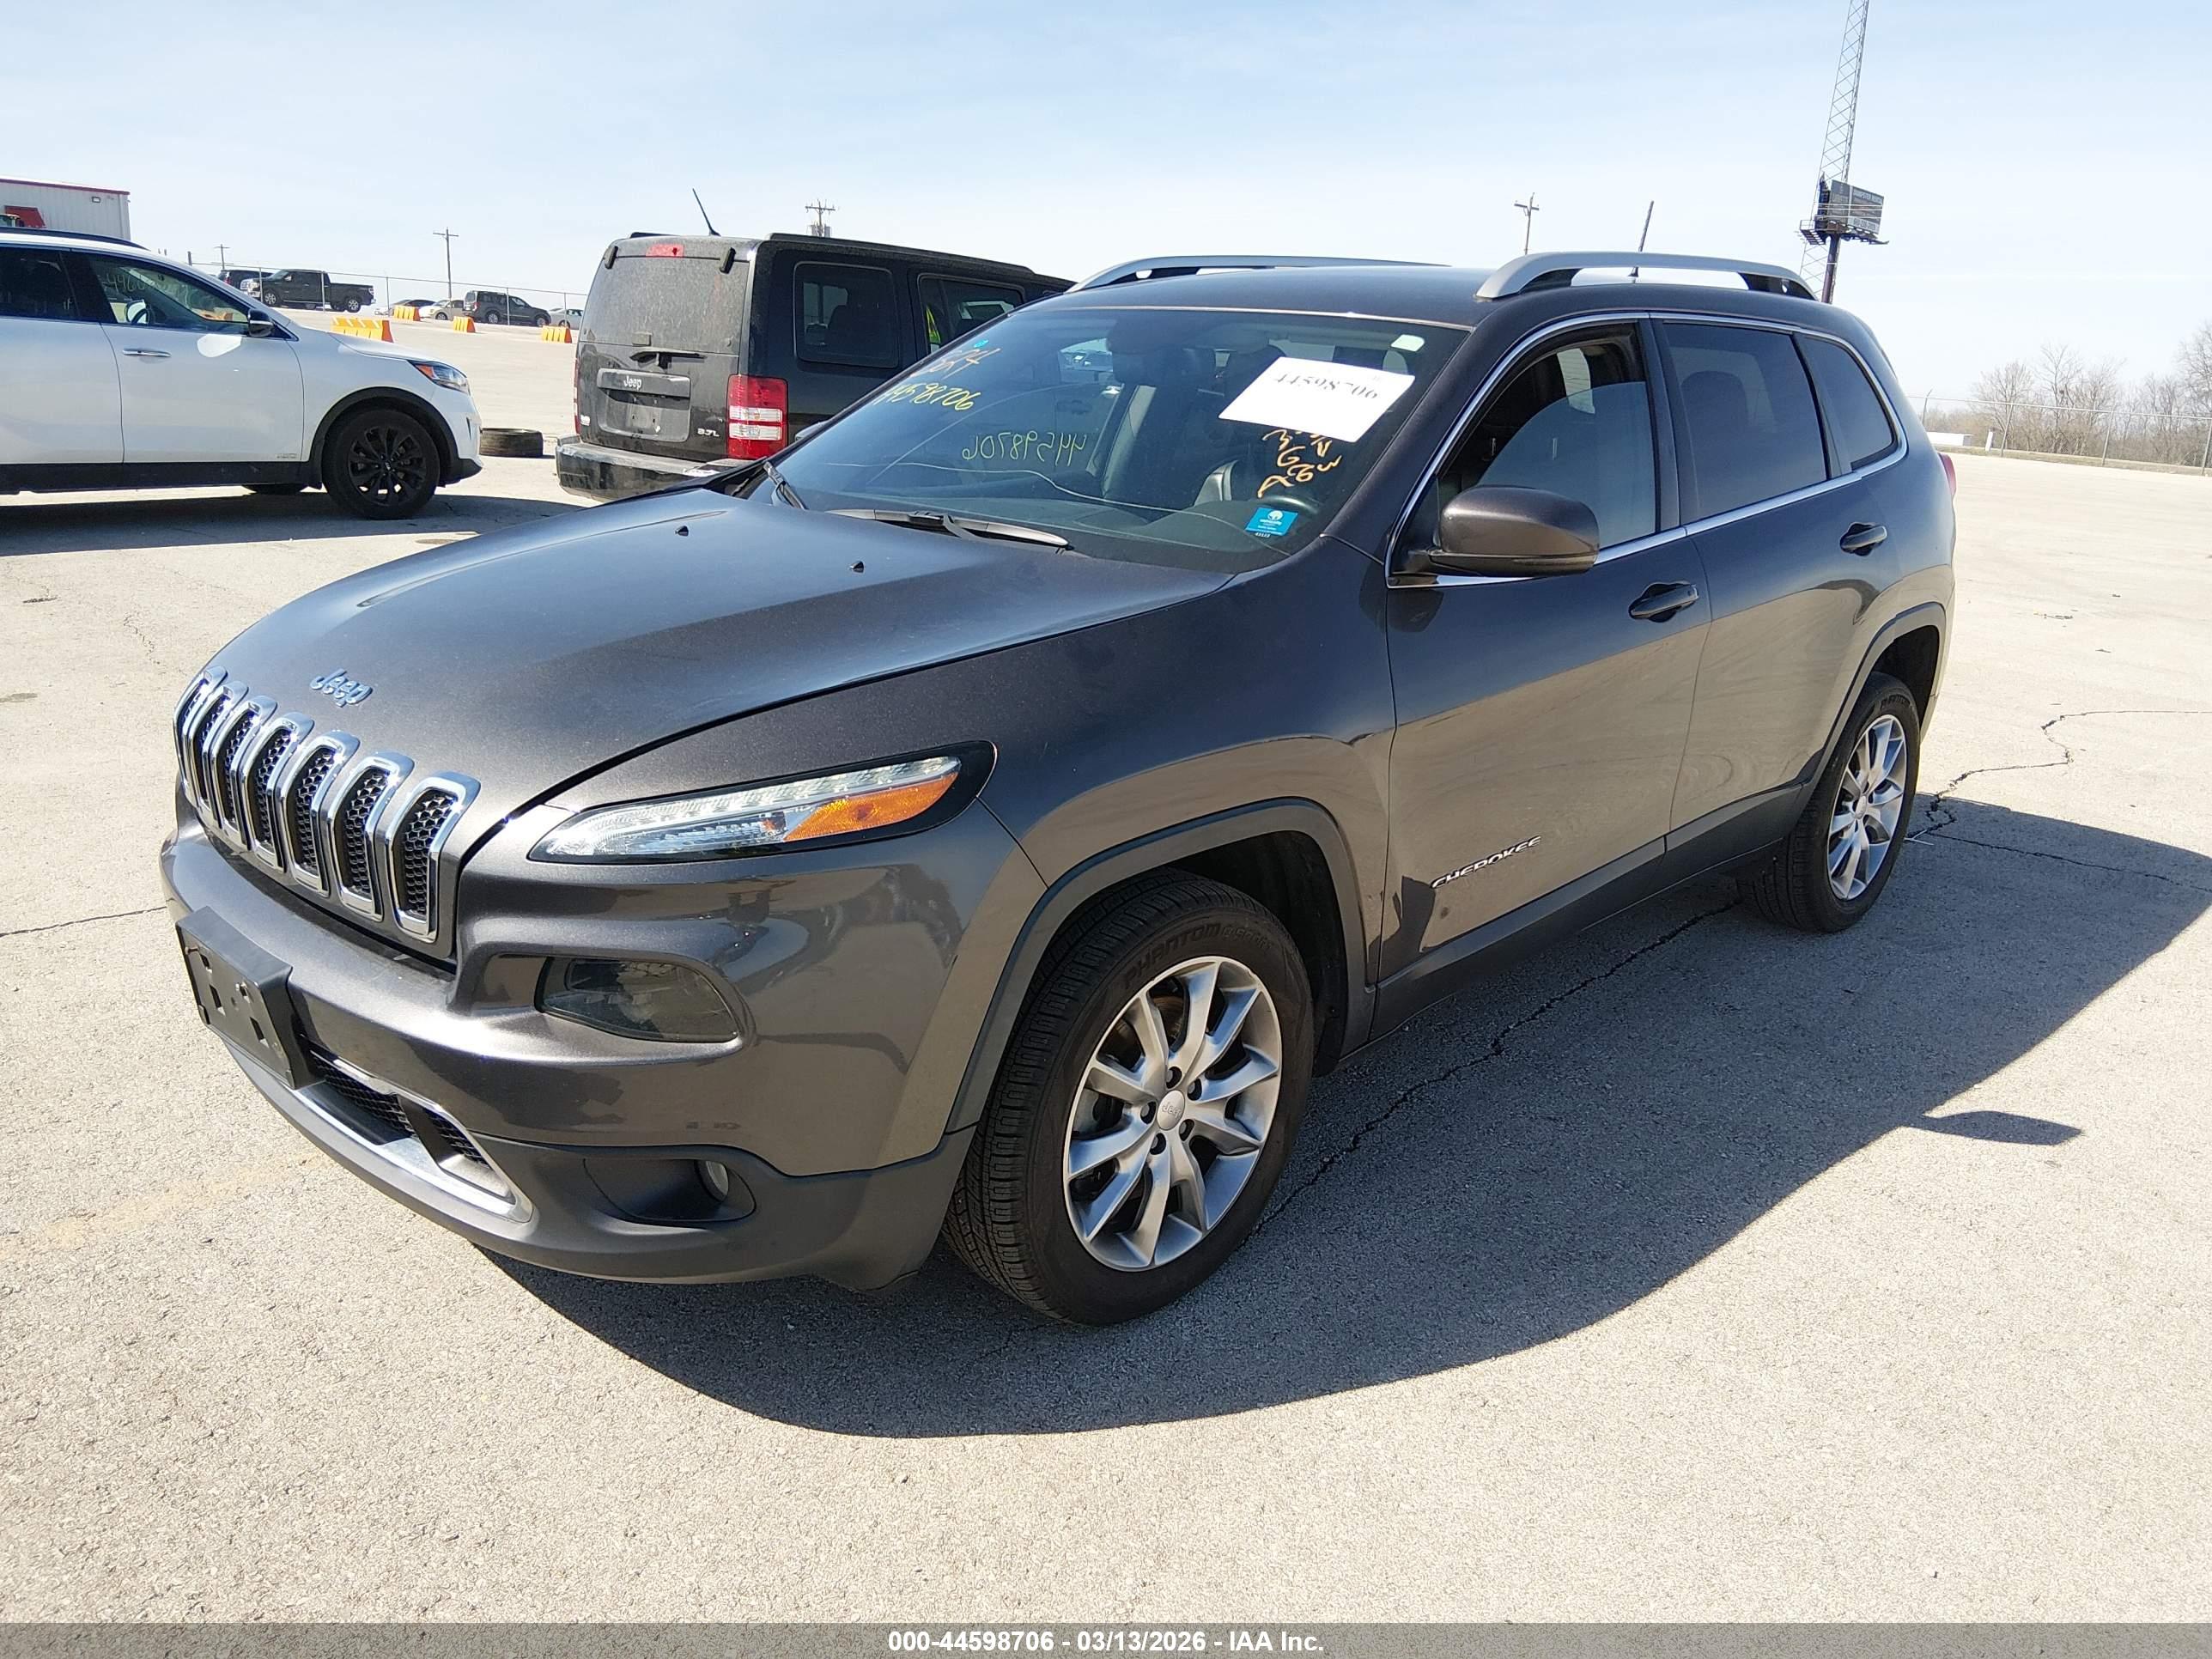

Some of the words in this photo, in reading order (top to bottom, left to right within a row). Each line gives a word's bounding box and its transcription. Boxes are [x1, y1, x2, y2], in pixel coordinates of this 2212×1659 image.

[623, 375, 642, 390] Jeep
[310, 669, 373, 708] Jeep
[1431, 835, 1542, 889] CHEROKEE
[1124, 922, 1222, 989] PHANTOM
